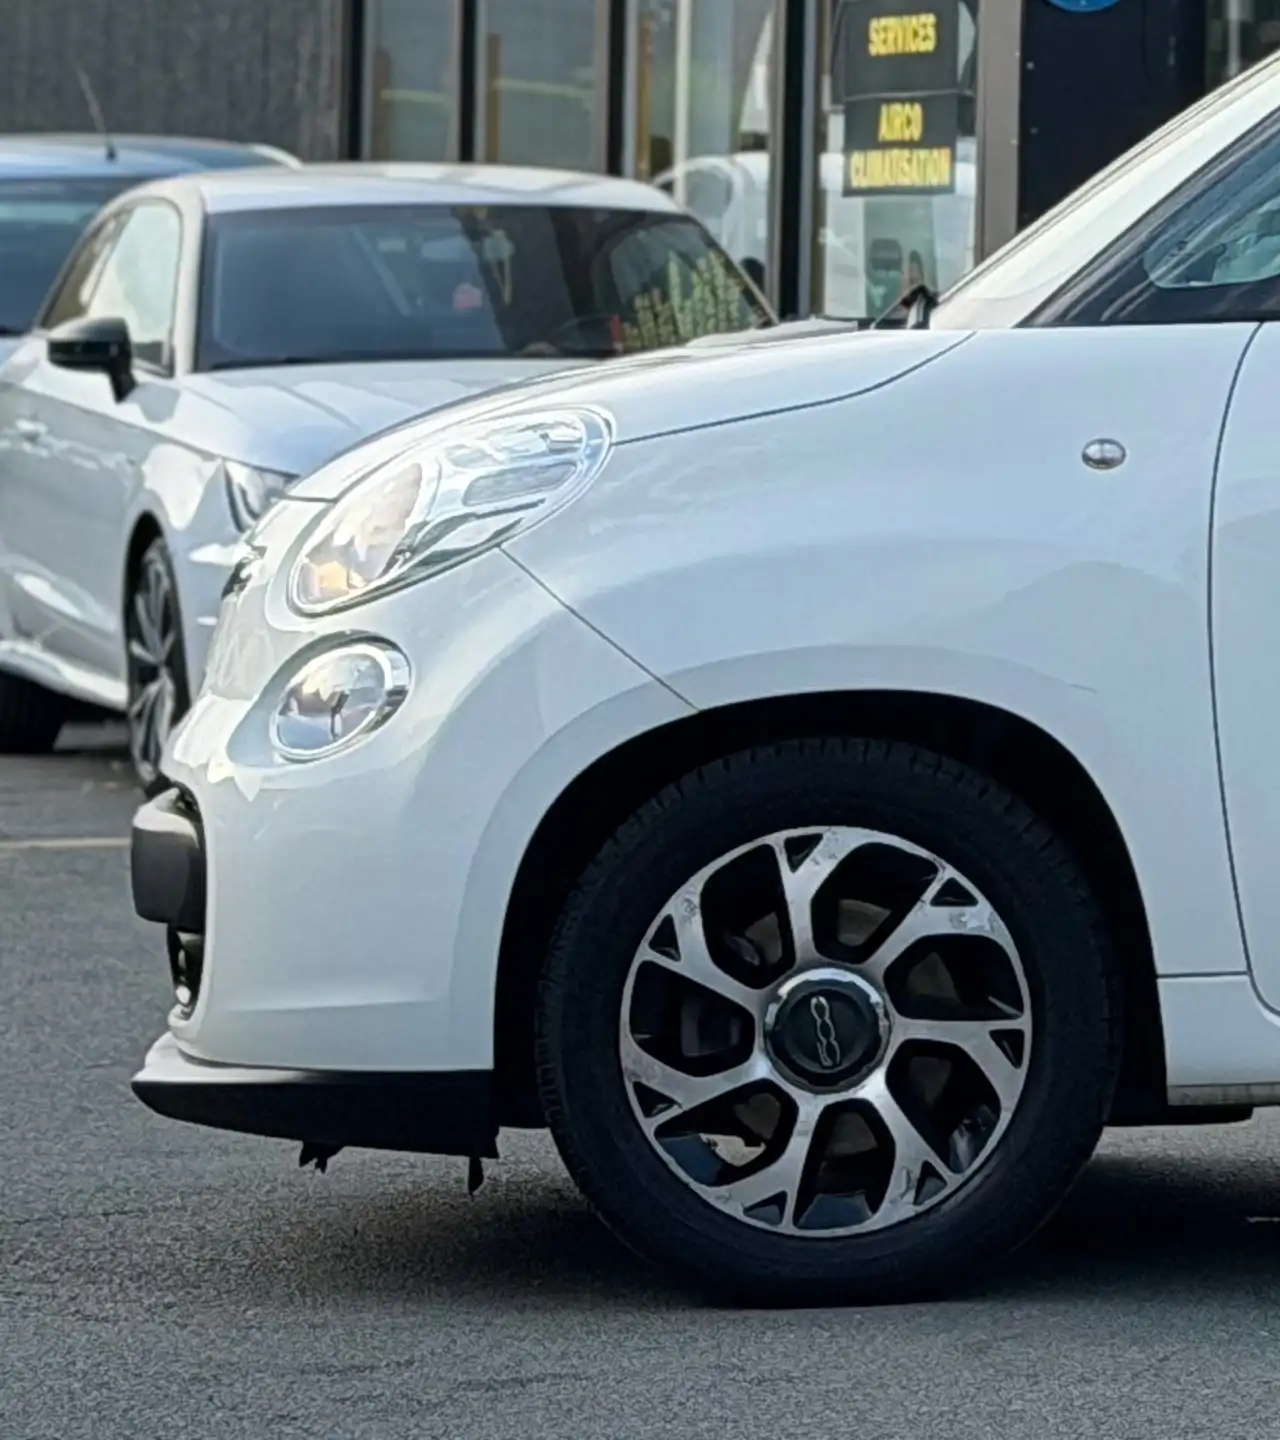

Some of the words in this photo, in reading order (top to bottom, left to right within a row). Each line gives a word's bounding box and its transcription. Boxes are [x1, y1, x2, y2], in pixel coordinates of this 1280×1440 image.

[868, 13, 937, 57] SERVICES
[878, 102, 923, 143] AIRCO
[850, 148, 951, 188] CLIMATISATION
